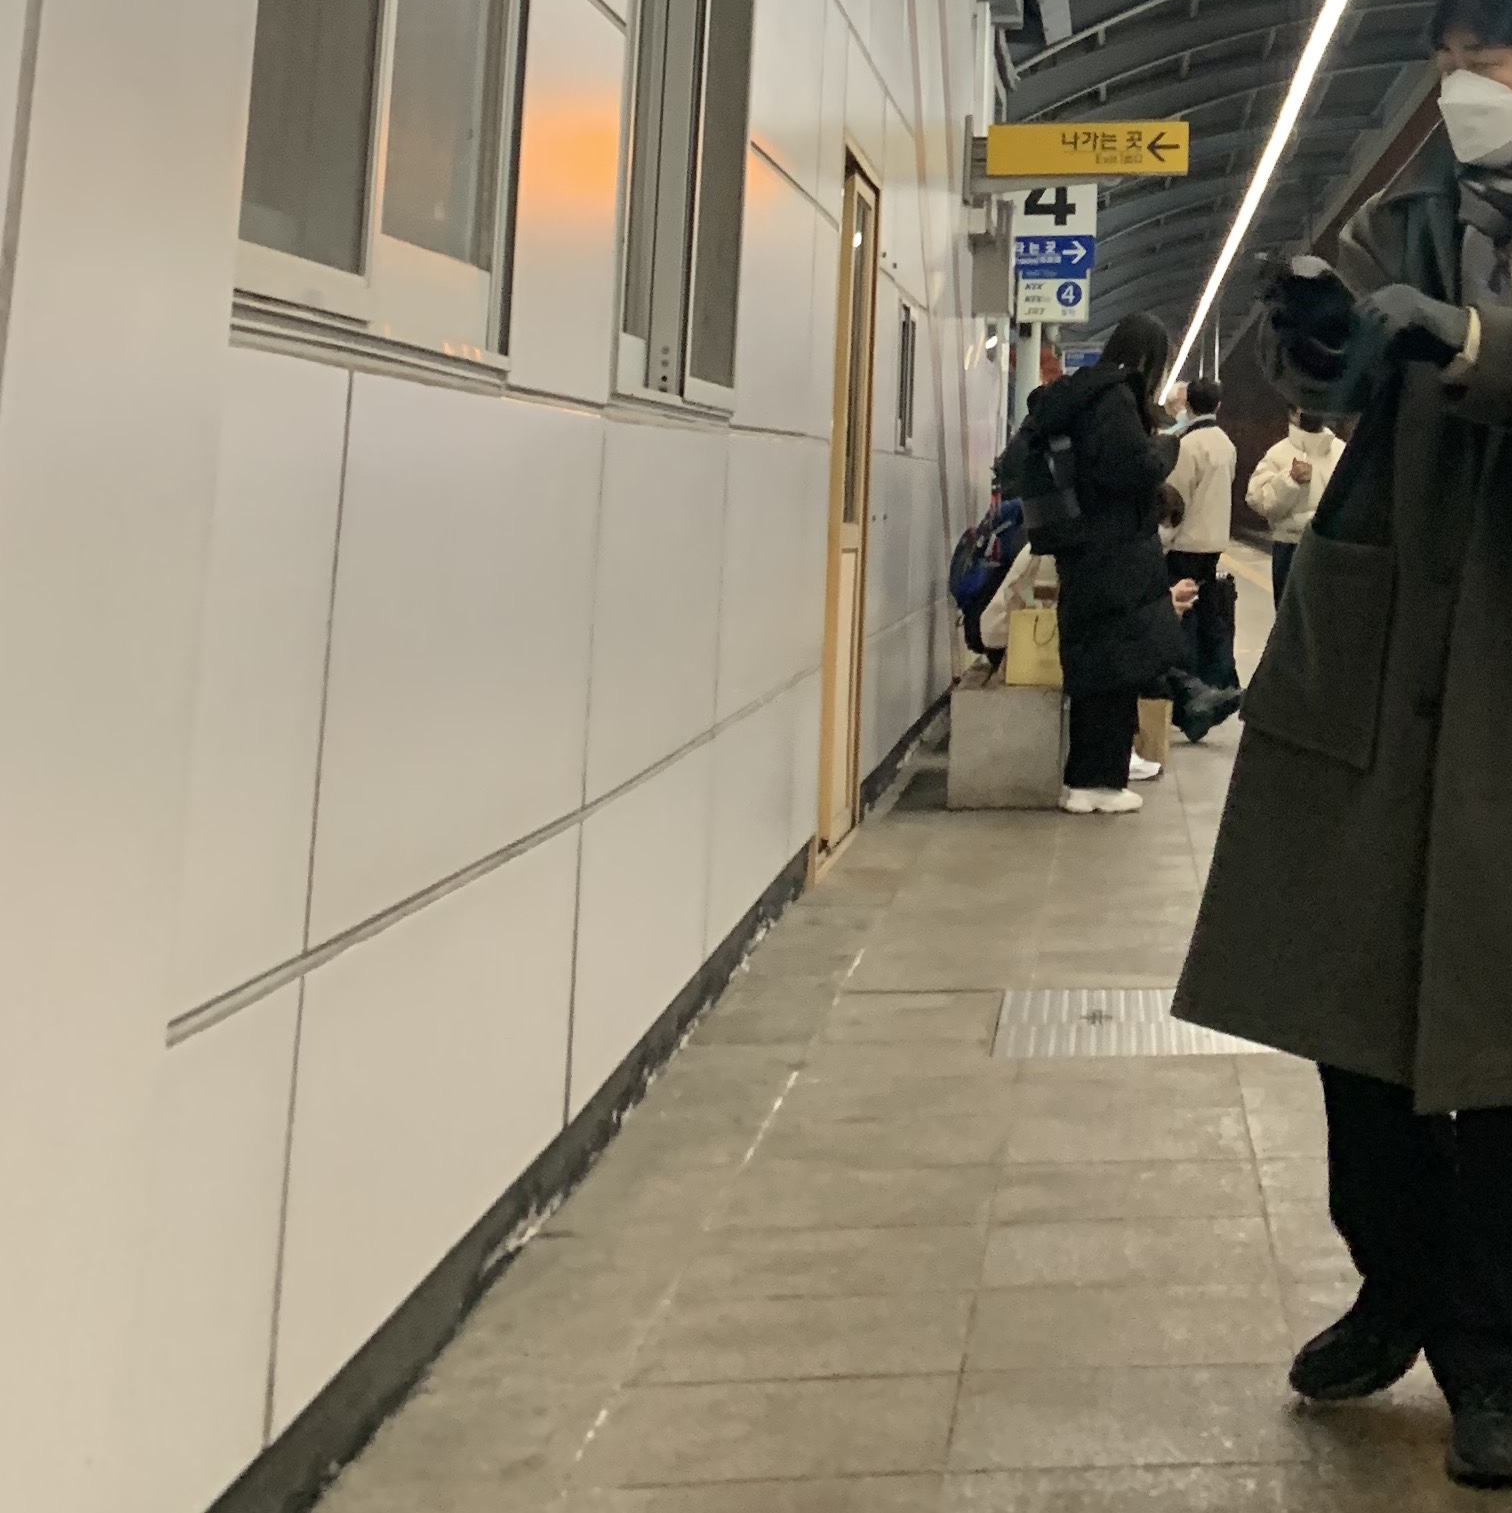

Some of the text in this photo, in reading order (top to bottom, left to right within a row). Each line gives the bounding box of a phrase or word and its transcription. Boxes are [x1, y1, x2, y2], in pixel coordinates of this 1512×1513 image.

[1061, 130, 1143, 151] 나가는 곳
[1024, 186, 1077, 226] 4
[1061, 285, 1076, 303] 4
